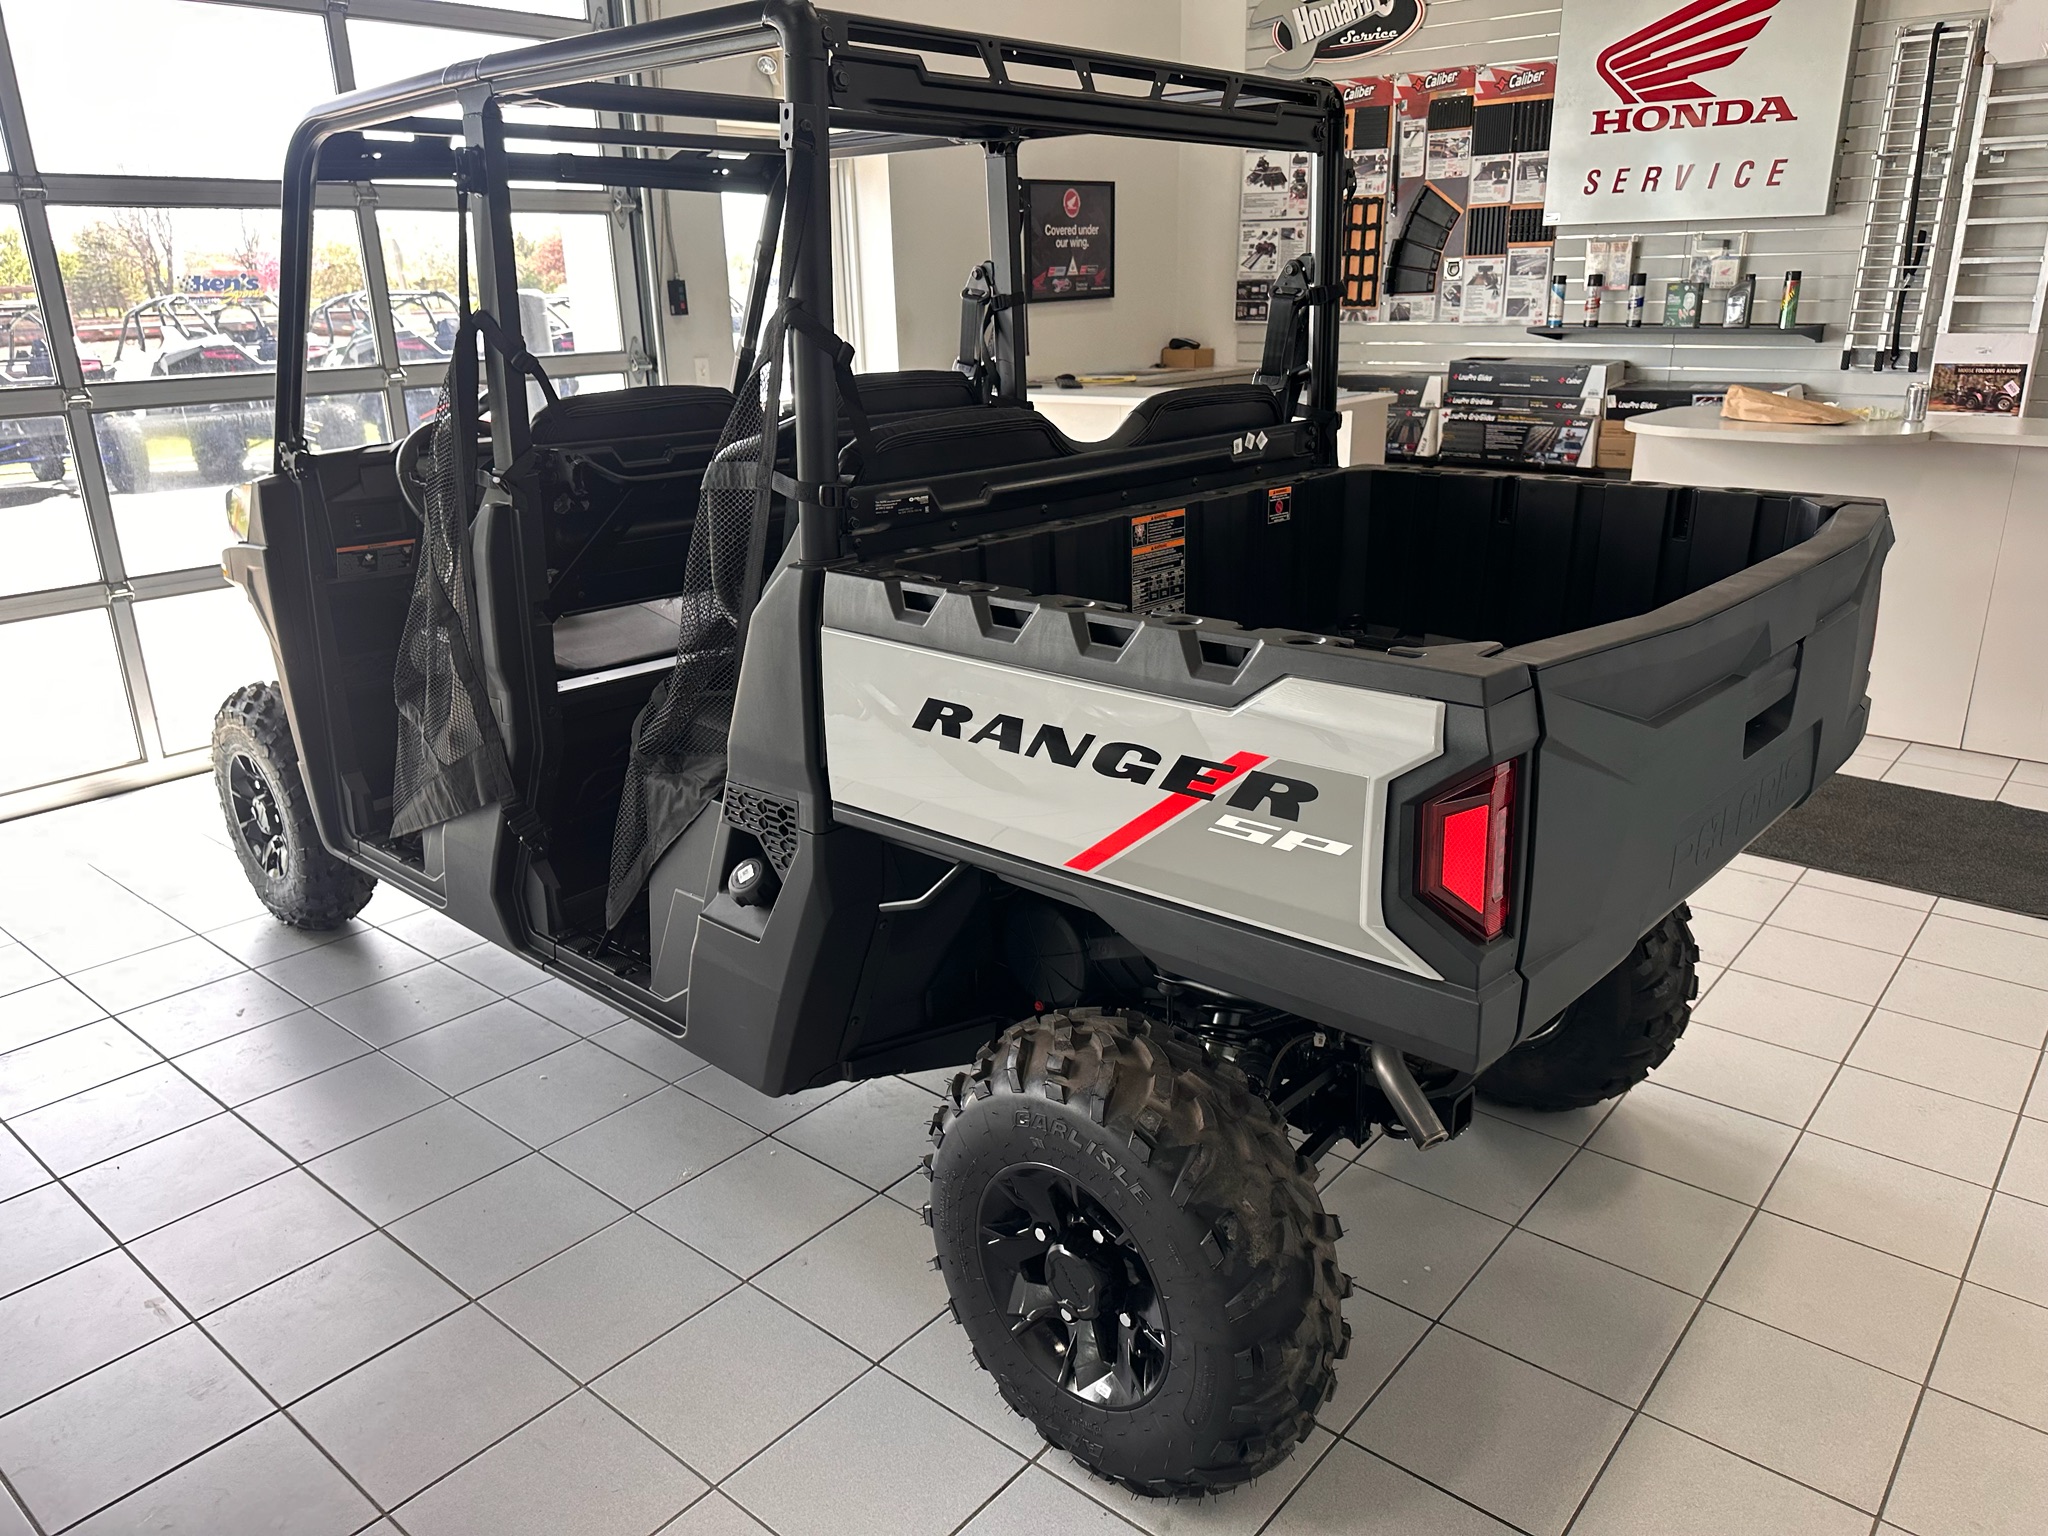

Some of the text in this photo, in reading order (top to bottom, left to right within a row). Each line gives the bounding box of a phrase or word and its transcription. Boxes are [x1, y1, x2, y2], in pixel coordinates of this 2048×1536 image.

[1340, 27, 1398, 45] Service
[1424, 69, 1460, 89] Caliber
[1508, 70, 1546, 88] Caliber
[1343, 85, 1375, 101] Caliber
[1590, 96, 1797, 135] HONDA
[1583, 158, 1788, 196] SERVICE
[1044, 224, 1099, 236] Covered under
[1055, 236, 1089, 250] our wing.
[192, 273, 259, 291] ken's
[912, 697, 1320, 823] RANGER
[1208, 814, 1353, 857] SP
[1014, 1109, 1152, 1206] CARLISLE
